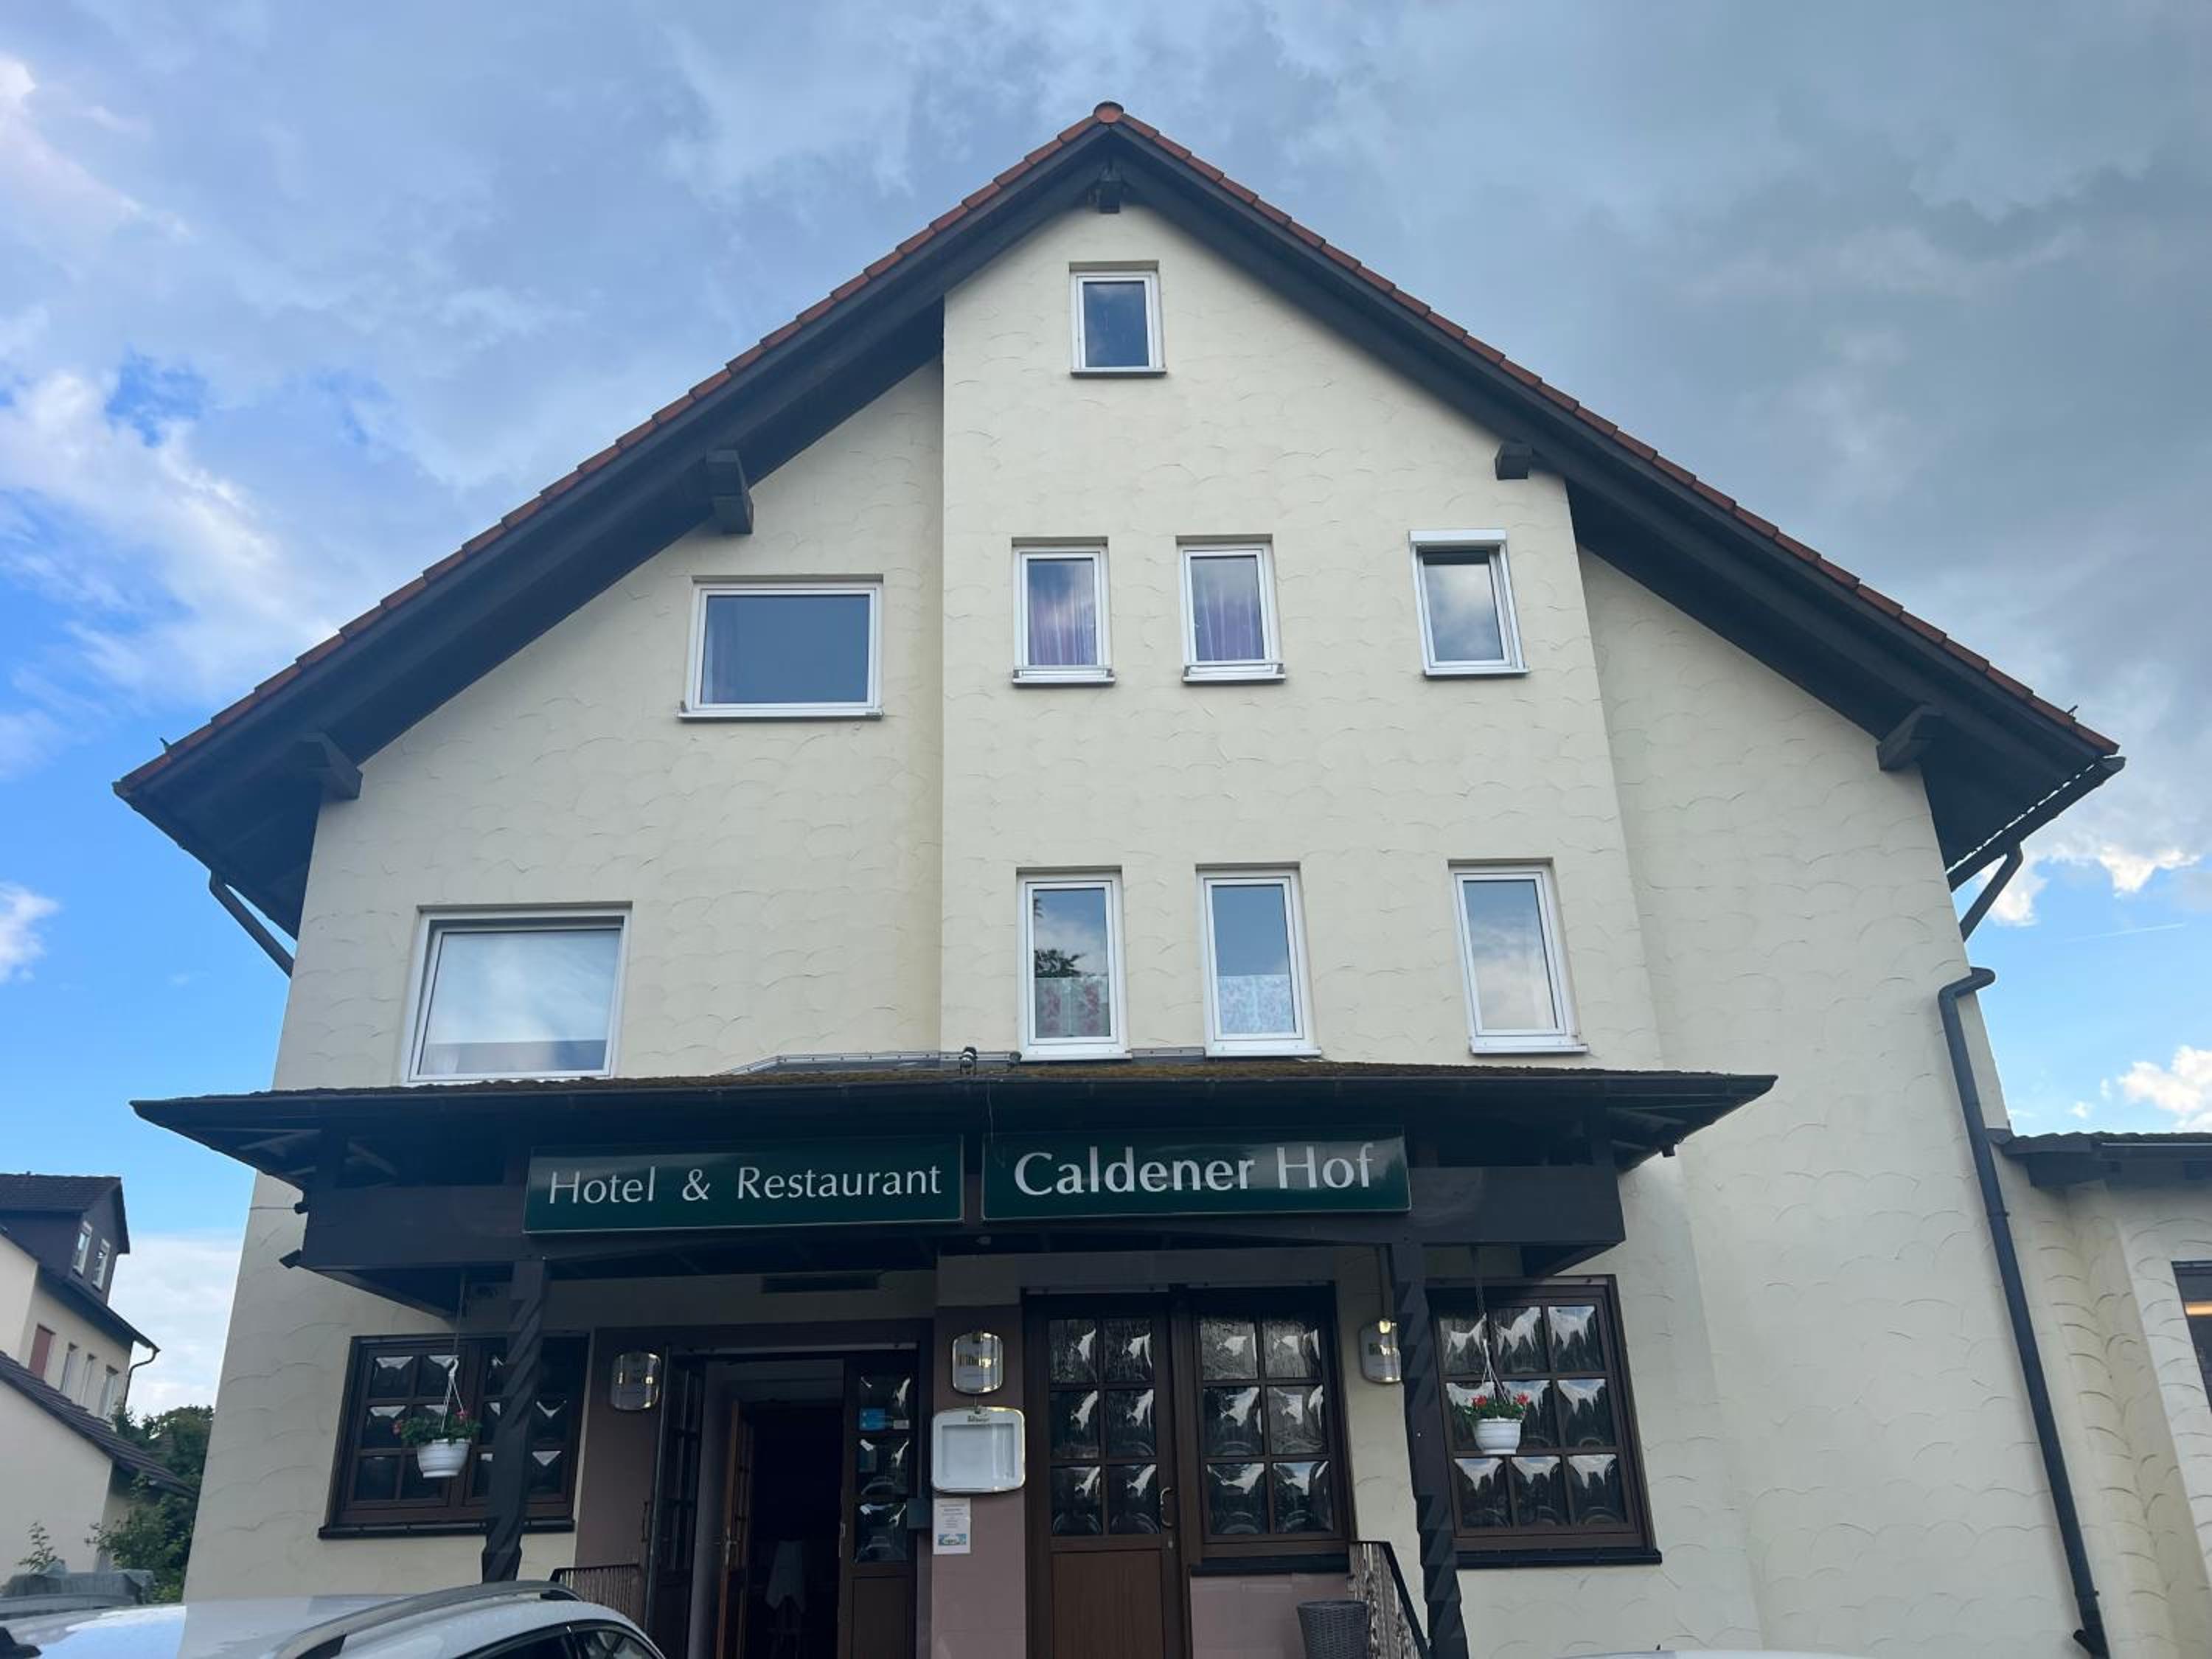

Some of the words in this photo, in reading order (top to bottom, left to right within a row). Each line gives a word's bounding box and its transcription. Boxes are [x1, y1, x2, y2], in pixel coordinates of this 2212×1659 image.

[549, 1166, 655, 1203] Hotel
[681, 1169, 710, 1201] &
[738, 1165, 942, 1200] Restaurant
[1014, 1146, 1255, 1195] Caldener
[1276, 1142, 1374, 1189] Hof
